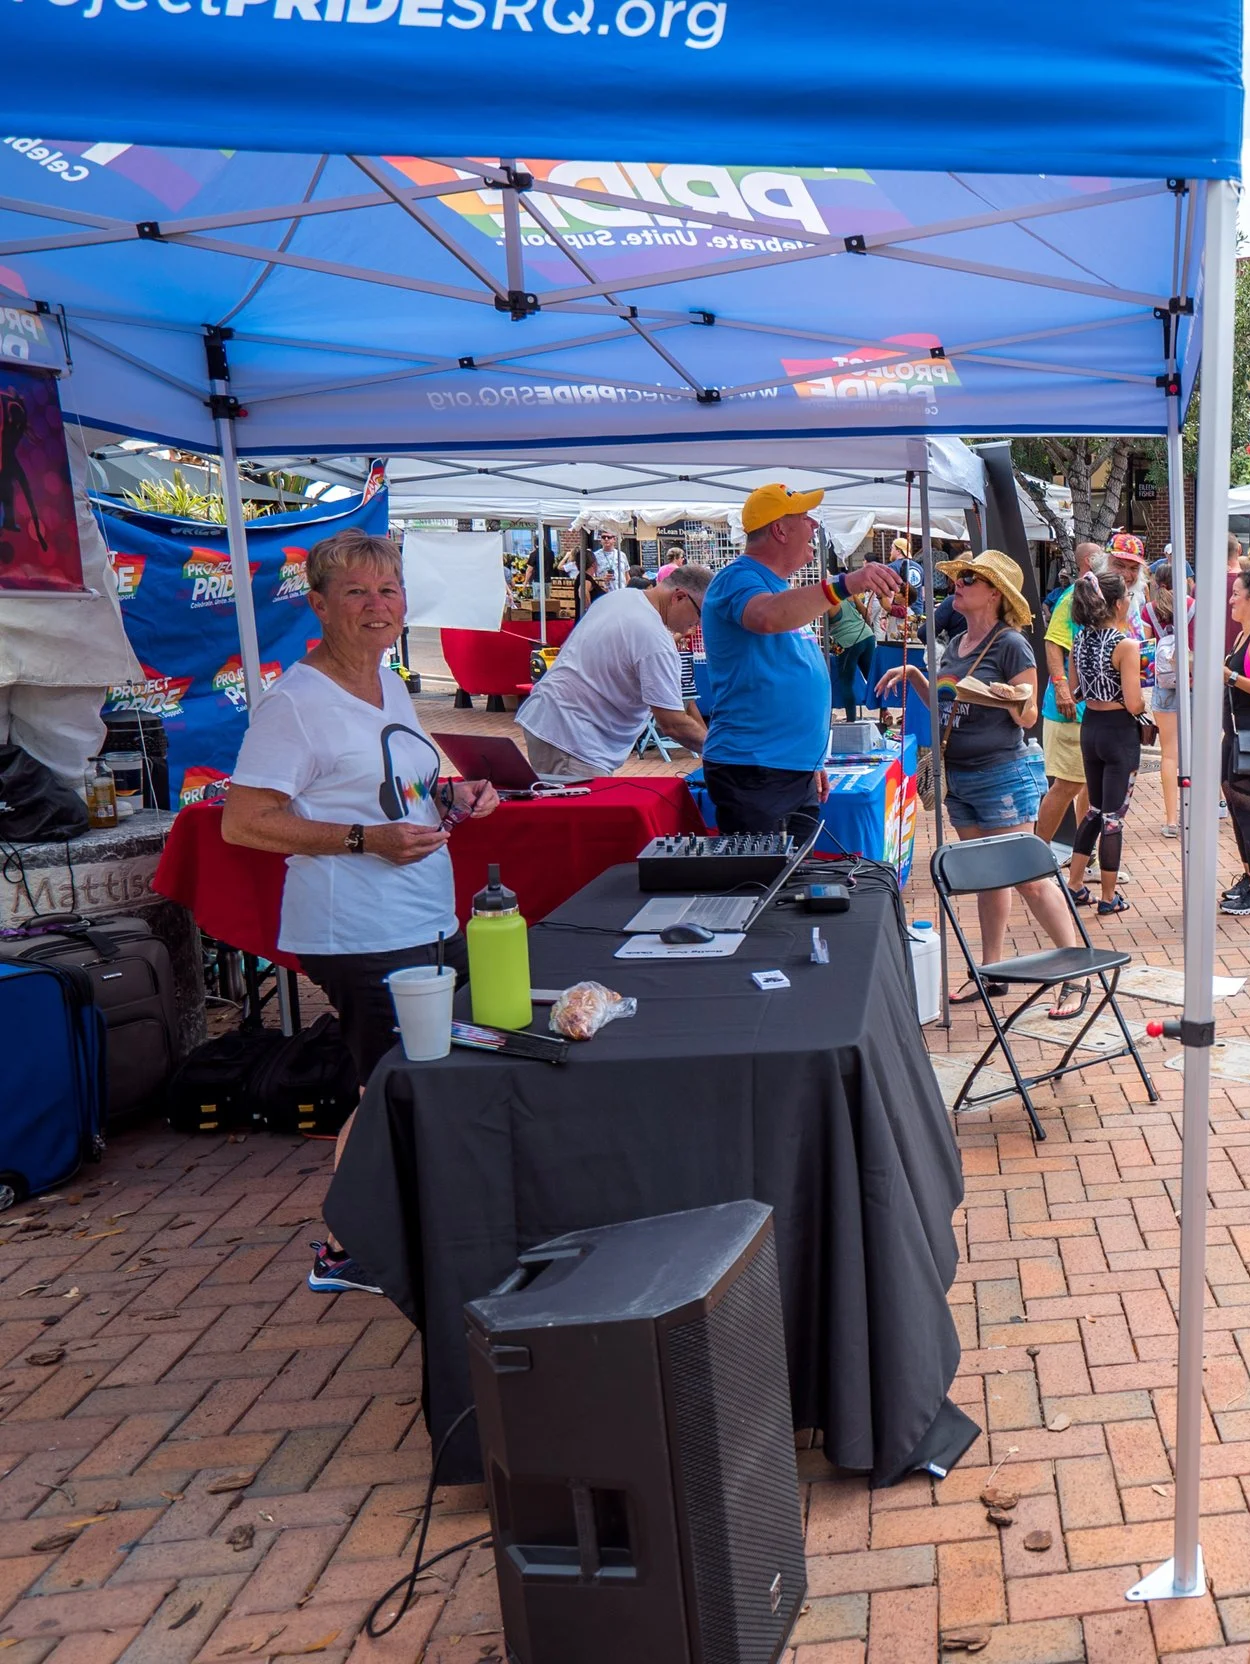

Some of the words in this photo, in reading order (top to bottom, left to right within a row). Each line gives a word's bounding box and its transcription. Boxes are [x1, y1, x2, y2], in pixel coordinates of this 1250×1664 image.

[187, 561, 232, 577] PROJEC
[192, 574, 235, 600] PRID
[111, 676, 172, 701] PROJECT
